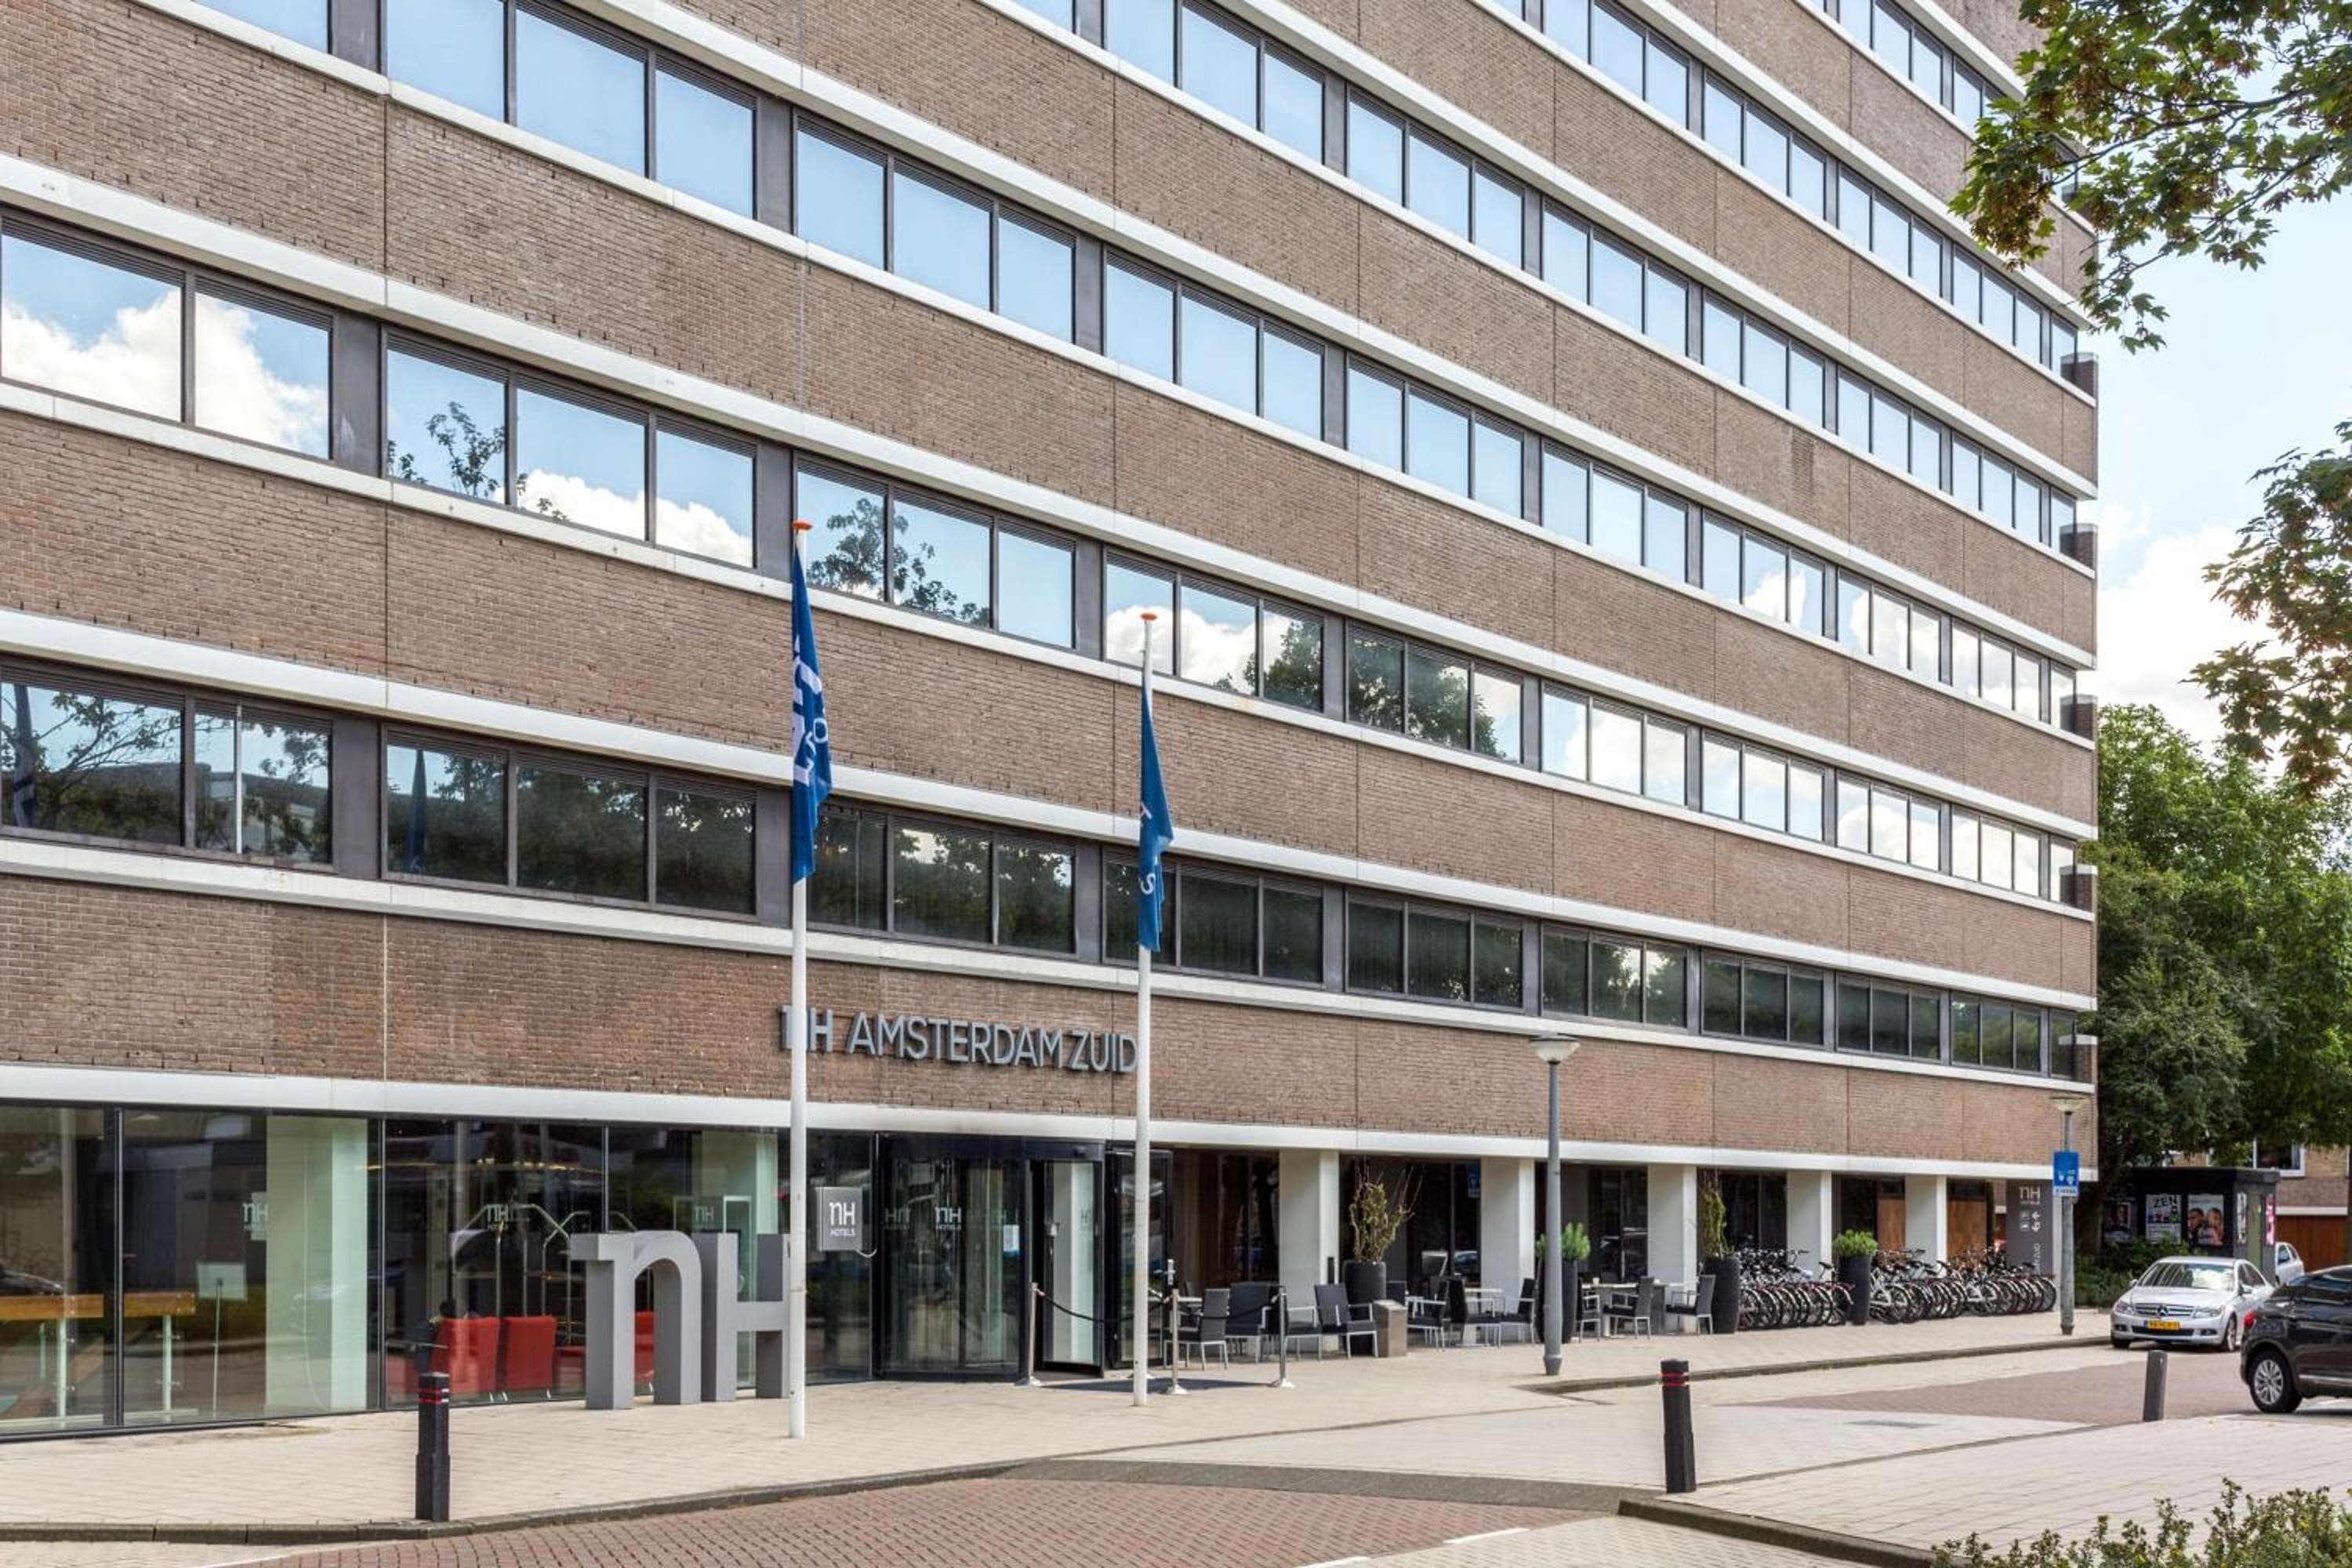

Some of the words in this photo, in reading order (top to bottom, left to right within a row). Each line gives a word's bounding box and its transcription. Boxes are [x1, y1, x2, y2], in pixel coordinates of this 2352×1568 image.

[848, 1011, 1062, 1069] AMSTERDAM
[1070, 1028, 1138, 1073] ZUID
[830, 1228, 855, 1236] HOTELS
